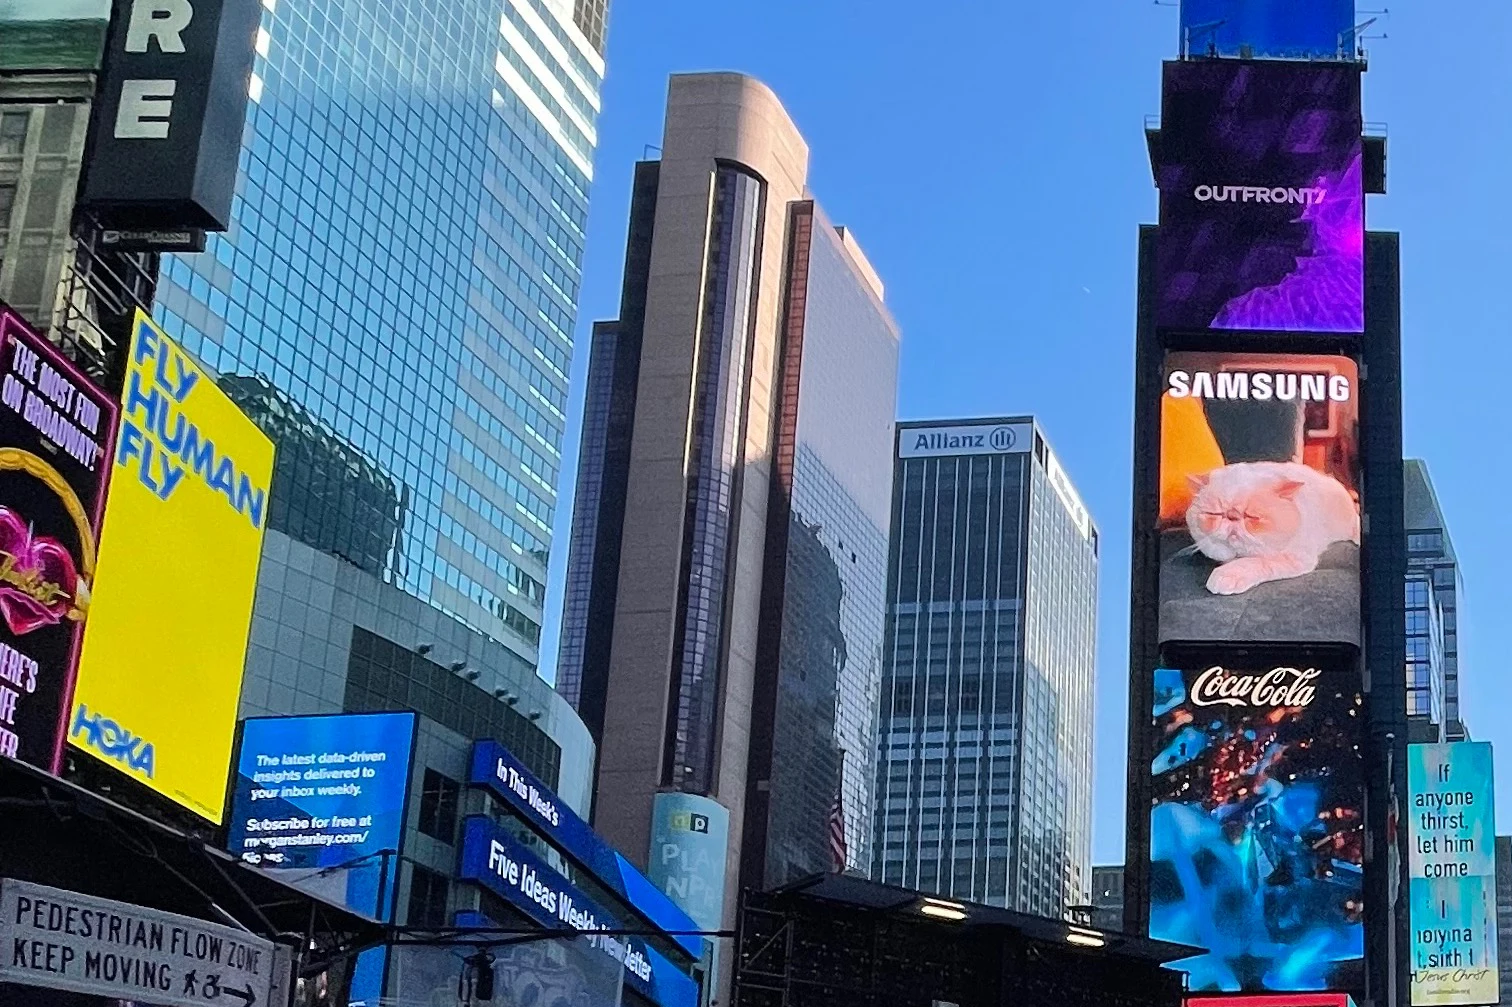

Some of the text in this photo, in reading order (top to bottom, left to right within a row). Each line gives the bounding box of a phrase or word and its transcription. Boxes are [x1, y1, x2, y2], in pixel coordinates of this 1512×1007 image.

[135, 319, 199, 403] FLY
[2, 373, 25, 413] ON
[13, 339, 100, 435] THE MOST FUN
[1168, 370, 1350, 401] SAMSUNG
[125, 370, 266, 529] HUMAN
[914, 433, 985, 450] Allianz
[118, 418, 184, 501] FLY
[1190, 665, 1322, 708] Coca-Cola
[71, 703, 155, 779] HOKA
[257, 751, 386, 766] The latest data-driven
[303, 767, 360, 780] delivered
[362, 767, 375, 778] to
[1439, 764, 1450, 782] If
[251, 788, 280, 801] your
[281, 786, 314, 797] inbox
[496, 758, 559, 826] In This Week's
[1415, 791, 1474, 812] anyone
[246, 815, 372, 831] Subscribe for free at
[1421, 811, 1469, 830] thirst,
[1417, 834, 1474, 854] let him
[488, 840, 519, 885] Five
[520, 863, 557, 914] Ideas
[1424, 862, 1468, 878] come
[16, 896, 262, 975] PEDESTRIAN FLOW ZONE
[13, 938, 172, 991] KEEP MOVING
[1452, 969, 1490, 983] Christ
